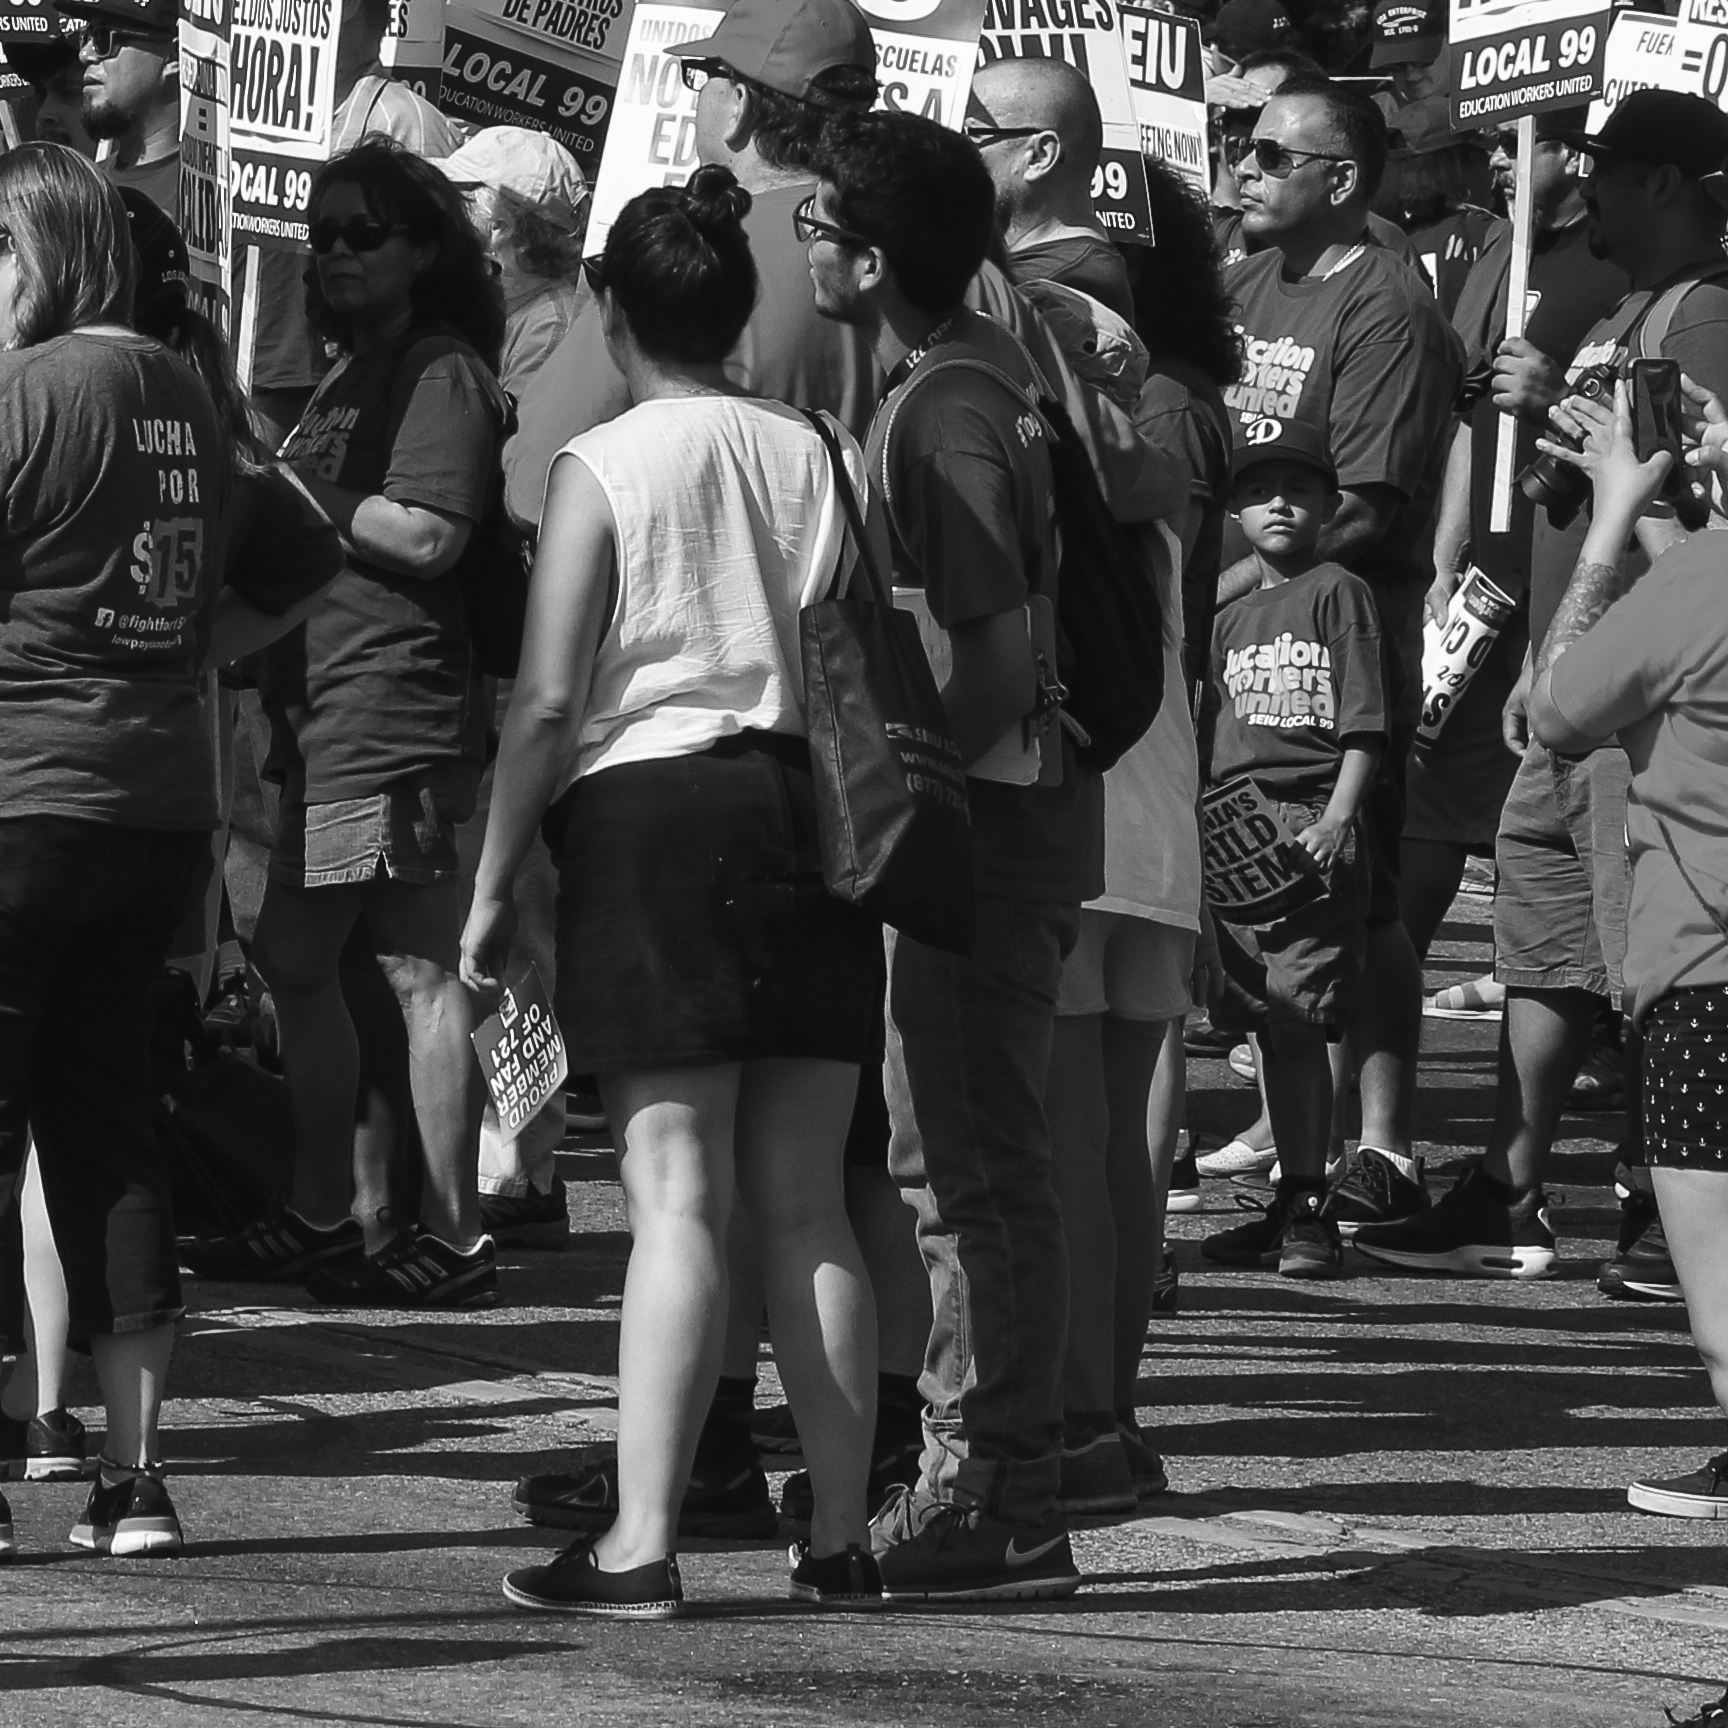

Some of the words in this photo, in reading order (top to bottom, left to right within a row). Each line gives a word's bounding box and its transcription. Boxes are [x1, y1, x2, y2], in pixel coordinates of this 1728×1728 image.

[1461, 35, 1550, 89] LOCAL
[1558, 26, 1596, 66] 99
[442, 42, 547, 107] LOCAL
[557, 86, 609, 126] 99
[1459, 91, 1510, 118] EDUCATION
[1511, 83, 1555, 111] WORKERS
[1556, 75, 1593, 99] UNITED
[133, 418, 196, 456] LUCHA
[158, 469, 199, 504] POR
[1234, 689, 1334, 721] united
[1248, 714, 1279, 727] SEIU
[1280, 714, 1316, 729] LOCAL
[1319, 719, 1334, 730] 99
[522, 1004, 540, 1035] OF
[522, 1014, 552, 1059] AND
[491, 1028, 519, 1068] 721
[490, 1053, 521, 1097] FAN
[497, 1034, 562, 1117] MEMBER
[509, 1062, 558, 1128] PROUD
